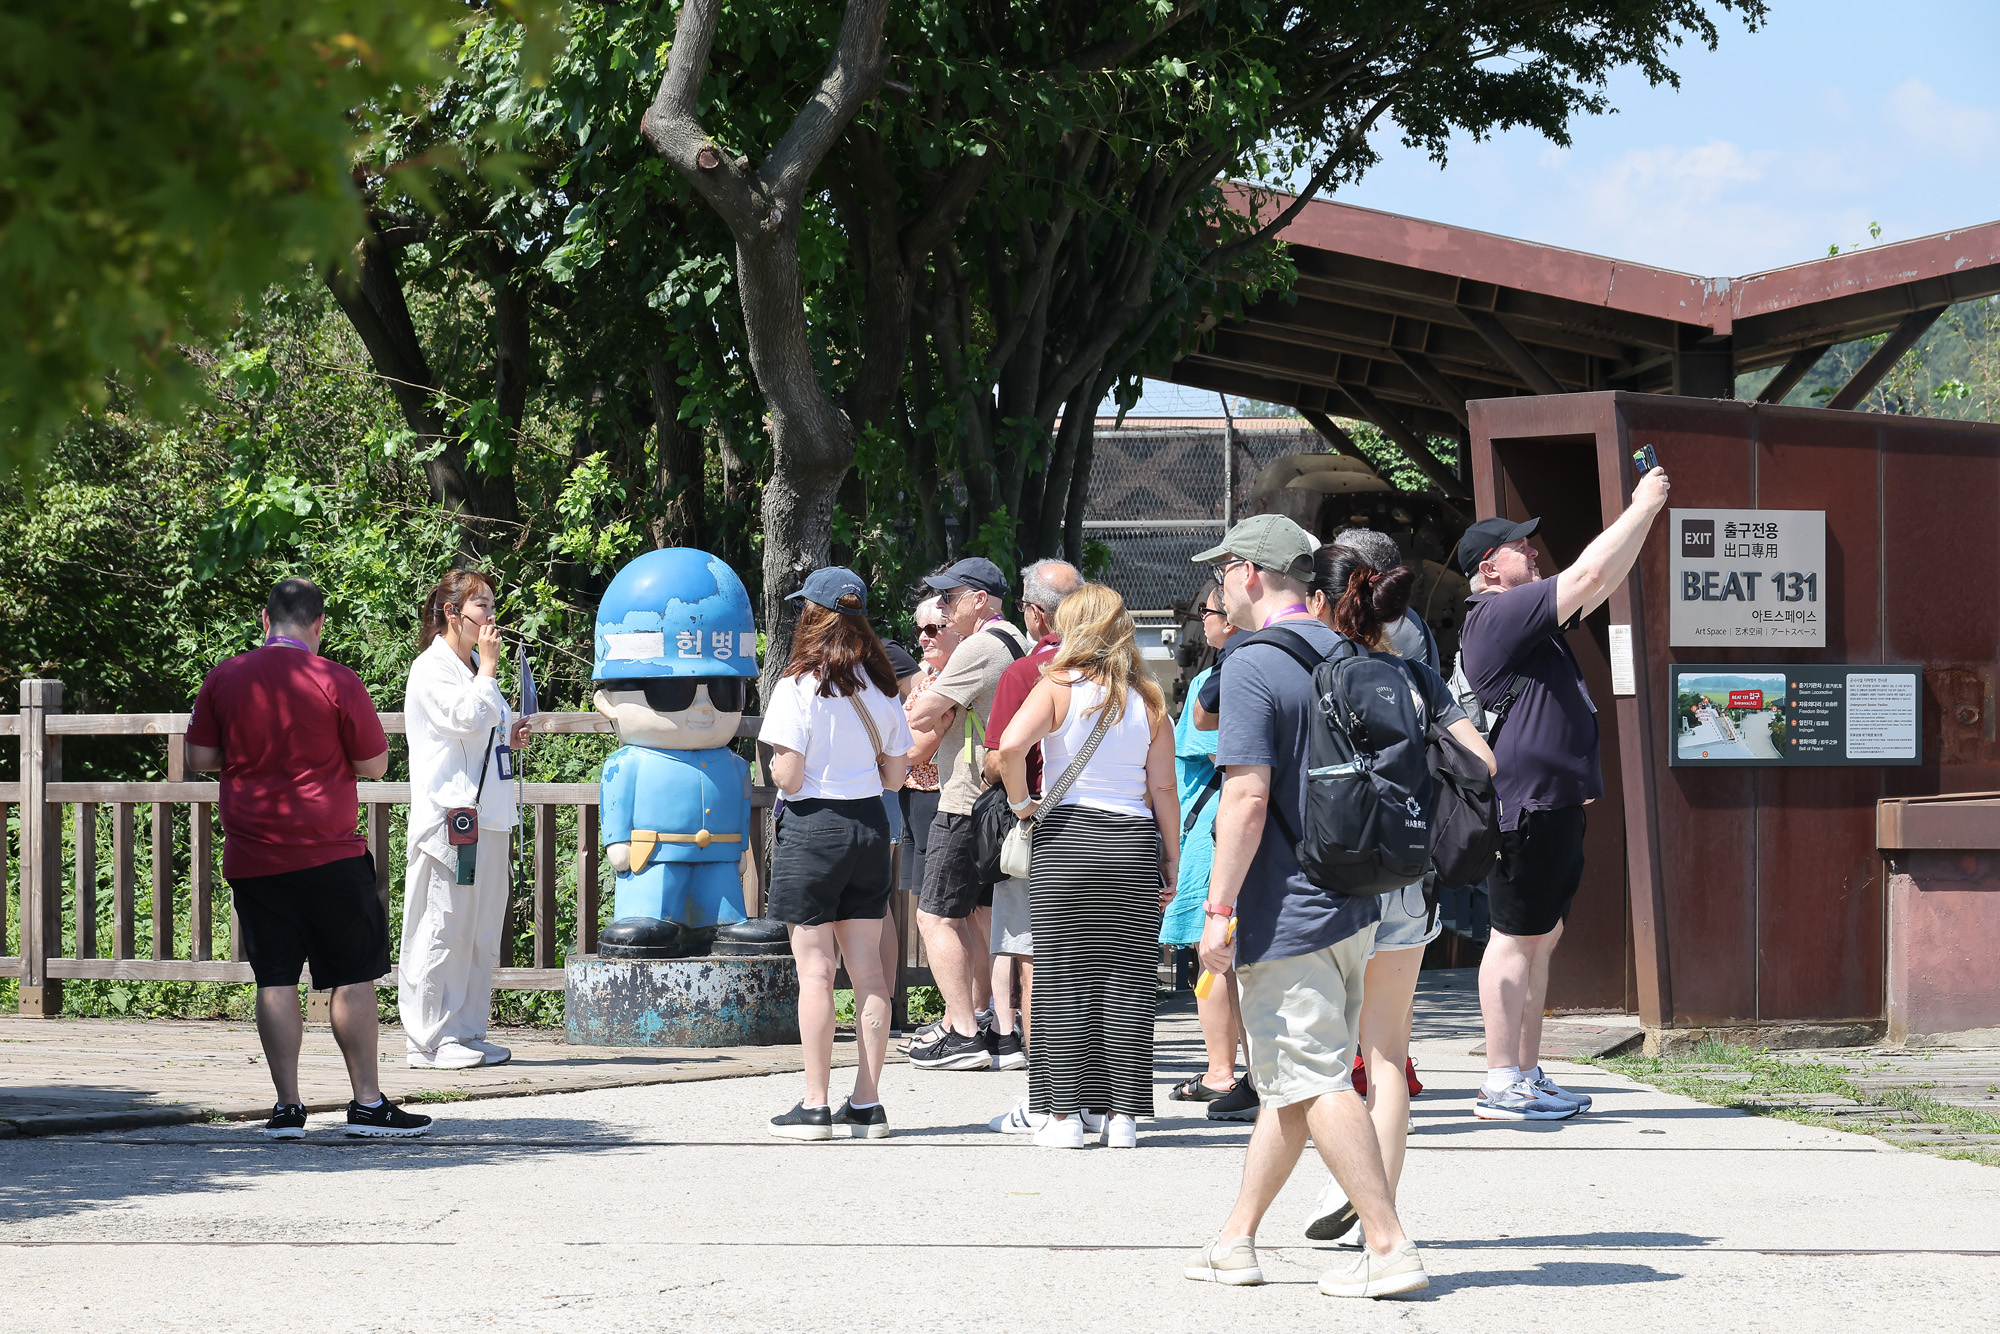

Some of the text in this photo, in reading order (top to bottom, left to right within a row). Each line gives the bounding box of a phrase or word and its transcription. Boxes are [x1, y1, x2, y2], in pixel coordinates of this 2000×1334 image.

[1724, 521, 1779, 539] 출구전용
[1685, 532, 1712, 545] EXIT
[1724, 542, 1778, 559] 出口專用
[1681, 571, 1817, 602] BEAT 131
[1751, 610, 1817, 624] 아트스페이스
[1695, 627, 1727, 637] Art Space
[1735, 627, 1763, 636] 艺术空间
[1771, 628, 1817, 636] アートスペース
[675, 629, 733, 660] 헌병
